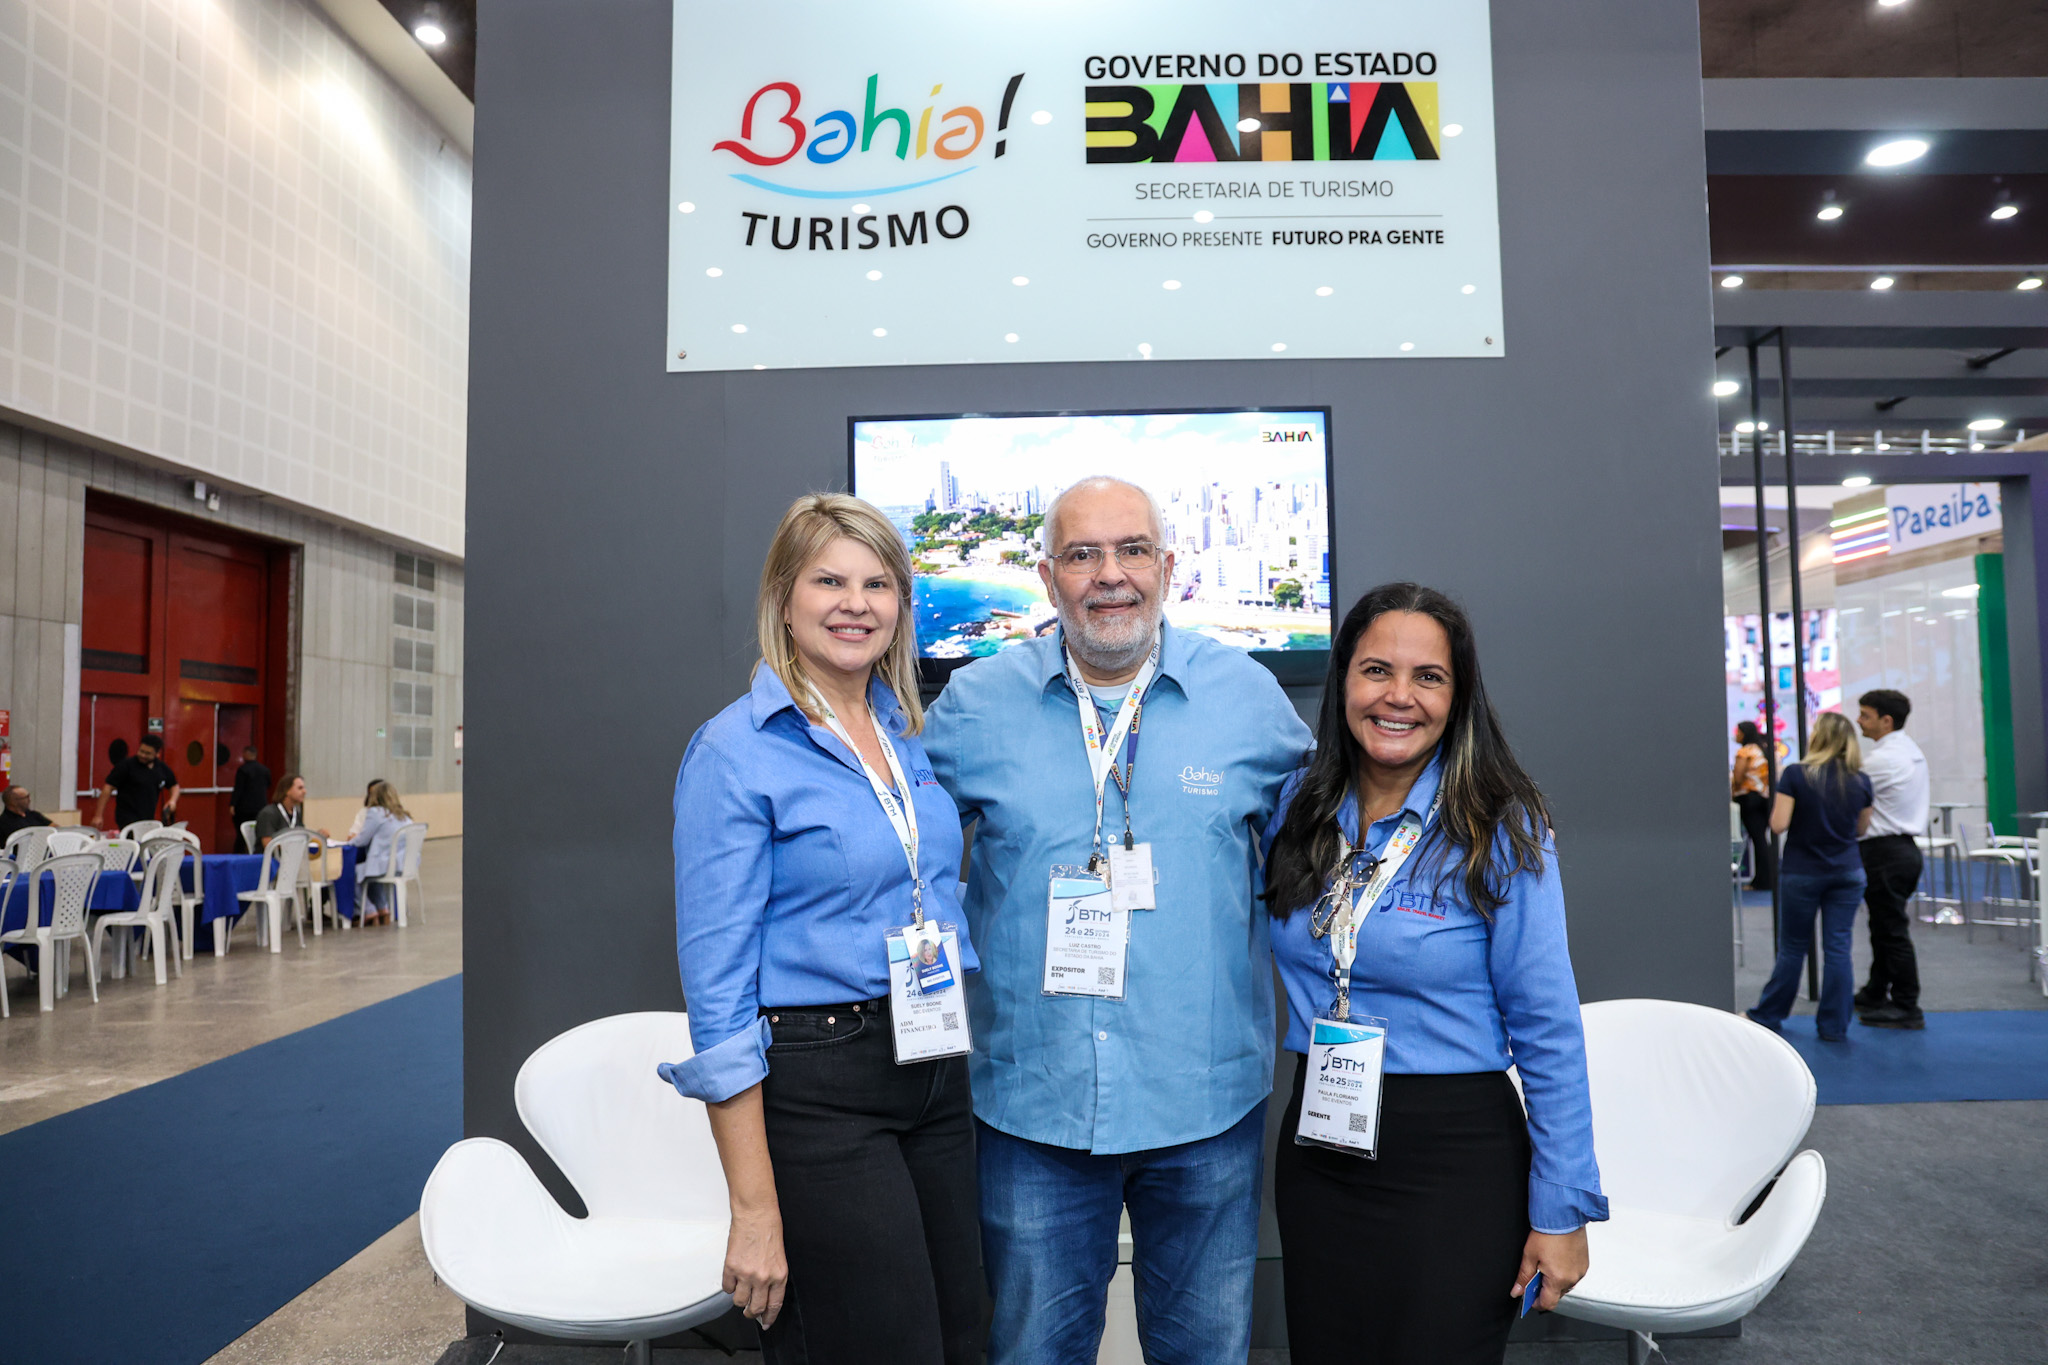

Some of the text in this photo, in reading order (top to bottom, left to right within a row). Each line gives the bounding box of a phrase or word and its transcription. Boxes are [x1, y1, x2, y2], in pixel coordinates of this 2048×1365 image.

[1085, 52, 1437, 79] GOVERNO DO ESTADO
[1085, 82, 1440, 164] BAHIA
[1136, 180, 1394, 199] SECRETARIA DE TURISMO
[741, 205, 970, 251] TURISMO
[1086, 230, 1445, 249] GOVERNO PRESENTE FUTURO PRA GENTE
[1262, 431, 1313, 442] BAHIA
[1182, 786, 1219, 796] TURISMO
[1400, 892, 1448, 915] BTM
[1079, 909, 1111, 922] BTM
[1084, 928, 1094, 936] 25
[906, 990, 916, 998] 24
[1332, 1057, 1364, 1072] BTM
[1320, 1074, 1329, 1082] 24
[1336, 1077, 1346, 1085] 25
[1333, 1092, 1359, 1101] FLORIANO
[1308, 1110, 1331, 1120] GERENTE
